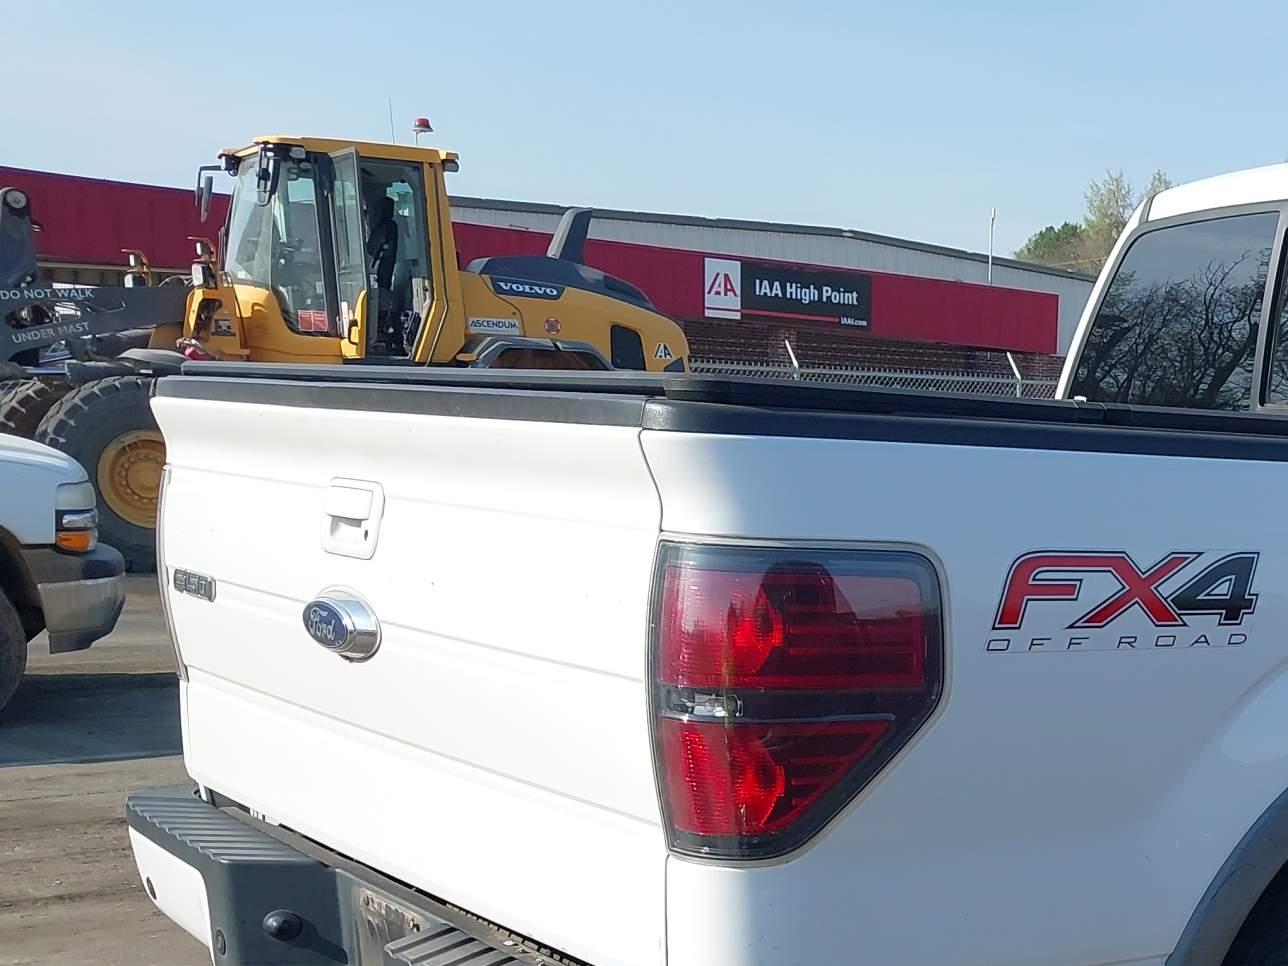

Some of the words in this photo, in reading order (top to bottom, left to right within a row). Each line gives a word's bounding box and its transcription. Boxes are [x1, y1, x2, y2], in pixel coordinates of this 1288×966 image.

[0, 290, 20, 299] DO
[24, 289, 52, 301] NOT
[56, 289, 94, 299] WALK
[497, 281, 558, 296] VOLVO
[755, 279, 783, 298] IAA
[786, 283, 818, 304] High
[822, 286, 859, 305] Point
[12, 328, 55, 343] UNDER
[58, 322, 89, 335] MAST
[470, 319, 518, 329] ASCENDUM
[991, 550, 1261, 630] FX4
[309, 606, 337, 641] Ford
